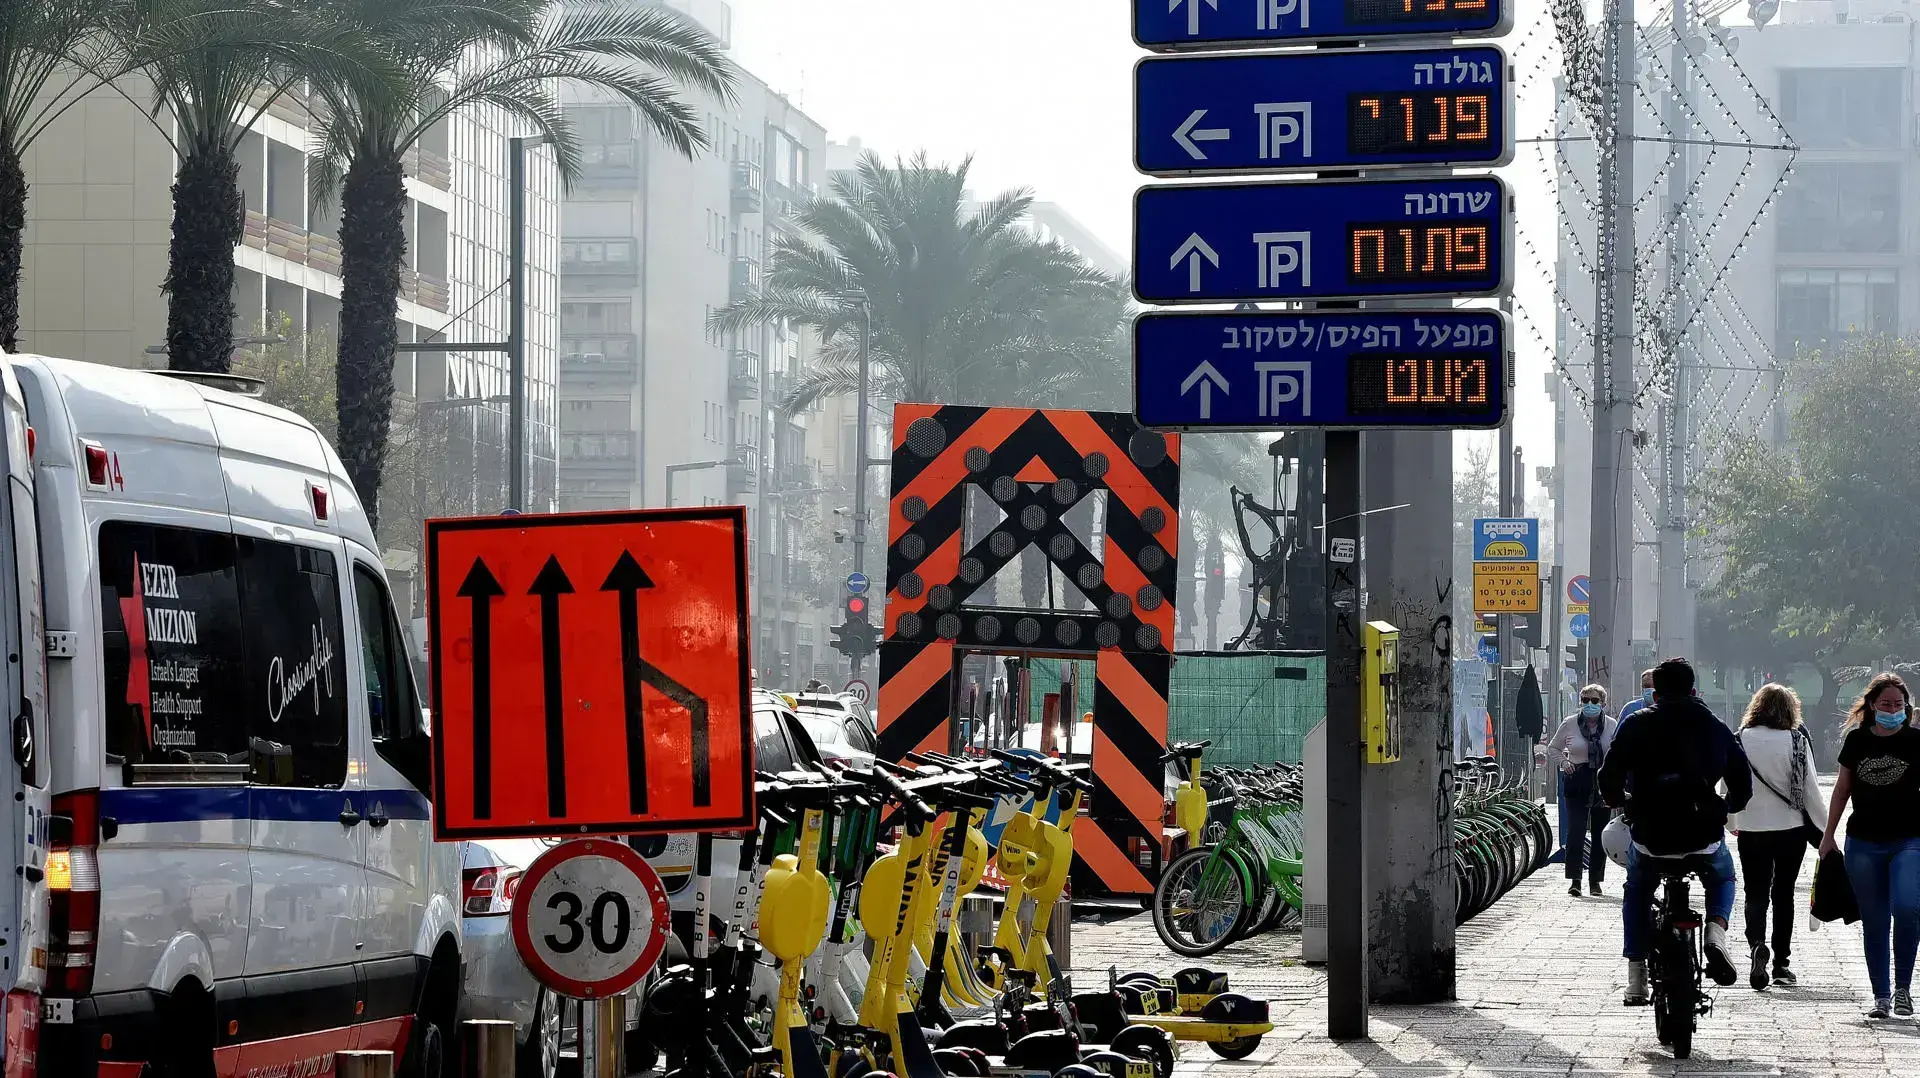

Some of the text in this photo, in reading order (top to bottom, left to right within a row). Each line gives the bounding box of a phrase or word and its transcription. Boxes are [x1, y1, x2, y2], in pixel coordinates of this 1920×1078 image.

[1414, 56, 1494, 85] גולדה
[1360, 94, 1488, 142] פנוי
[1404, 191, 1492, 215] שרונה
[1353, 226, 1487, 274] פתוח
[1222, 319, 1494, 352] מפעל הפיס/לסקוב
[1385, 358, 1487, 403] מעט
[141, 562, 179, 599] EZER
[1494, 589, 1506, 597] עד
[1499, 599, 1512, 607] עד
[146, 607, 198, 645] MIZION
[150, 659, 200, 689] Israel's Largest
[152, 692, 203, 721] Health Support
[153, 724, 196, 752] Organization
[544, 891, 631, 954] 30
[695, 891, 705, 942] BIRD
[731, 885, 748, 933] BIRD
[1128, 1064, 1151, 1075] 795
